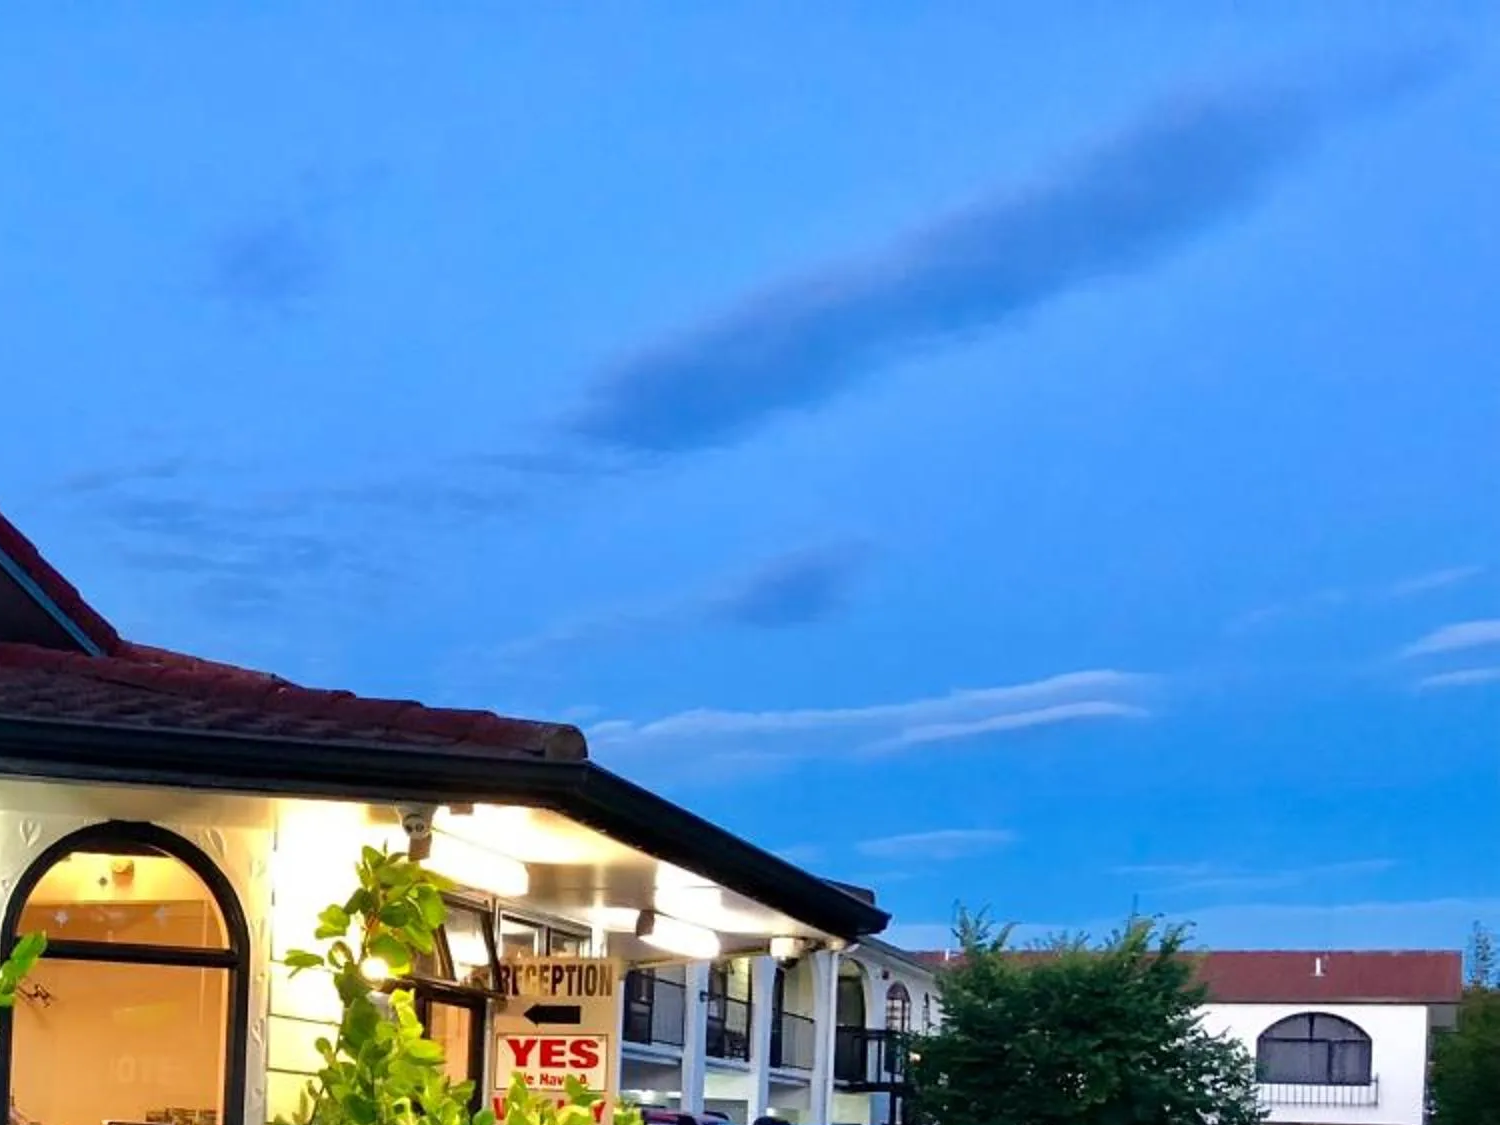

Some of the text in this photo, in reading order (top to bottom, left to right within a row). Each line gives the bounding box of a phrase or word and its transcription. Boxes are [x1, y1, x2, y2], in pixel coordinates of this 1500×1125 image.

[498, 963, 613, 997] RECEPTION
[506, 1038, 599, 1069] YES
[539, 1072, 567, 1086] Hav
